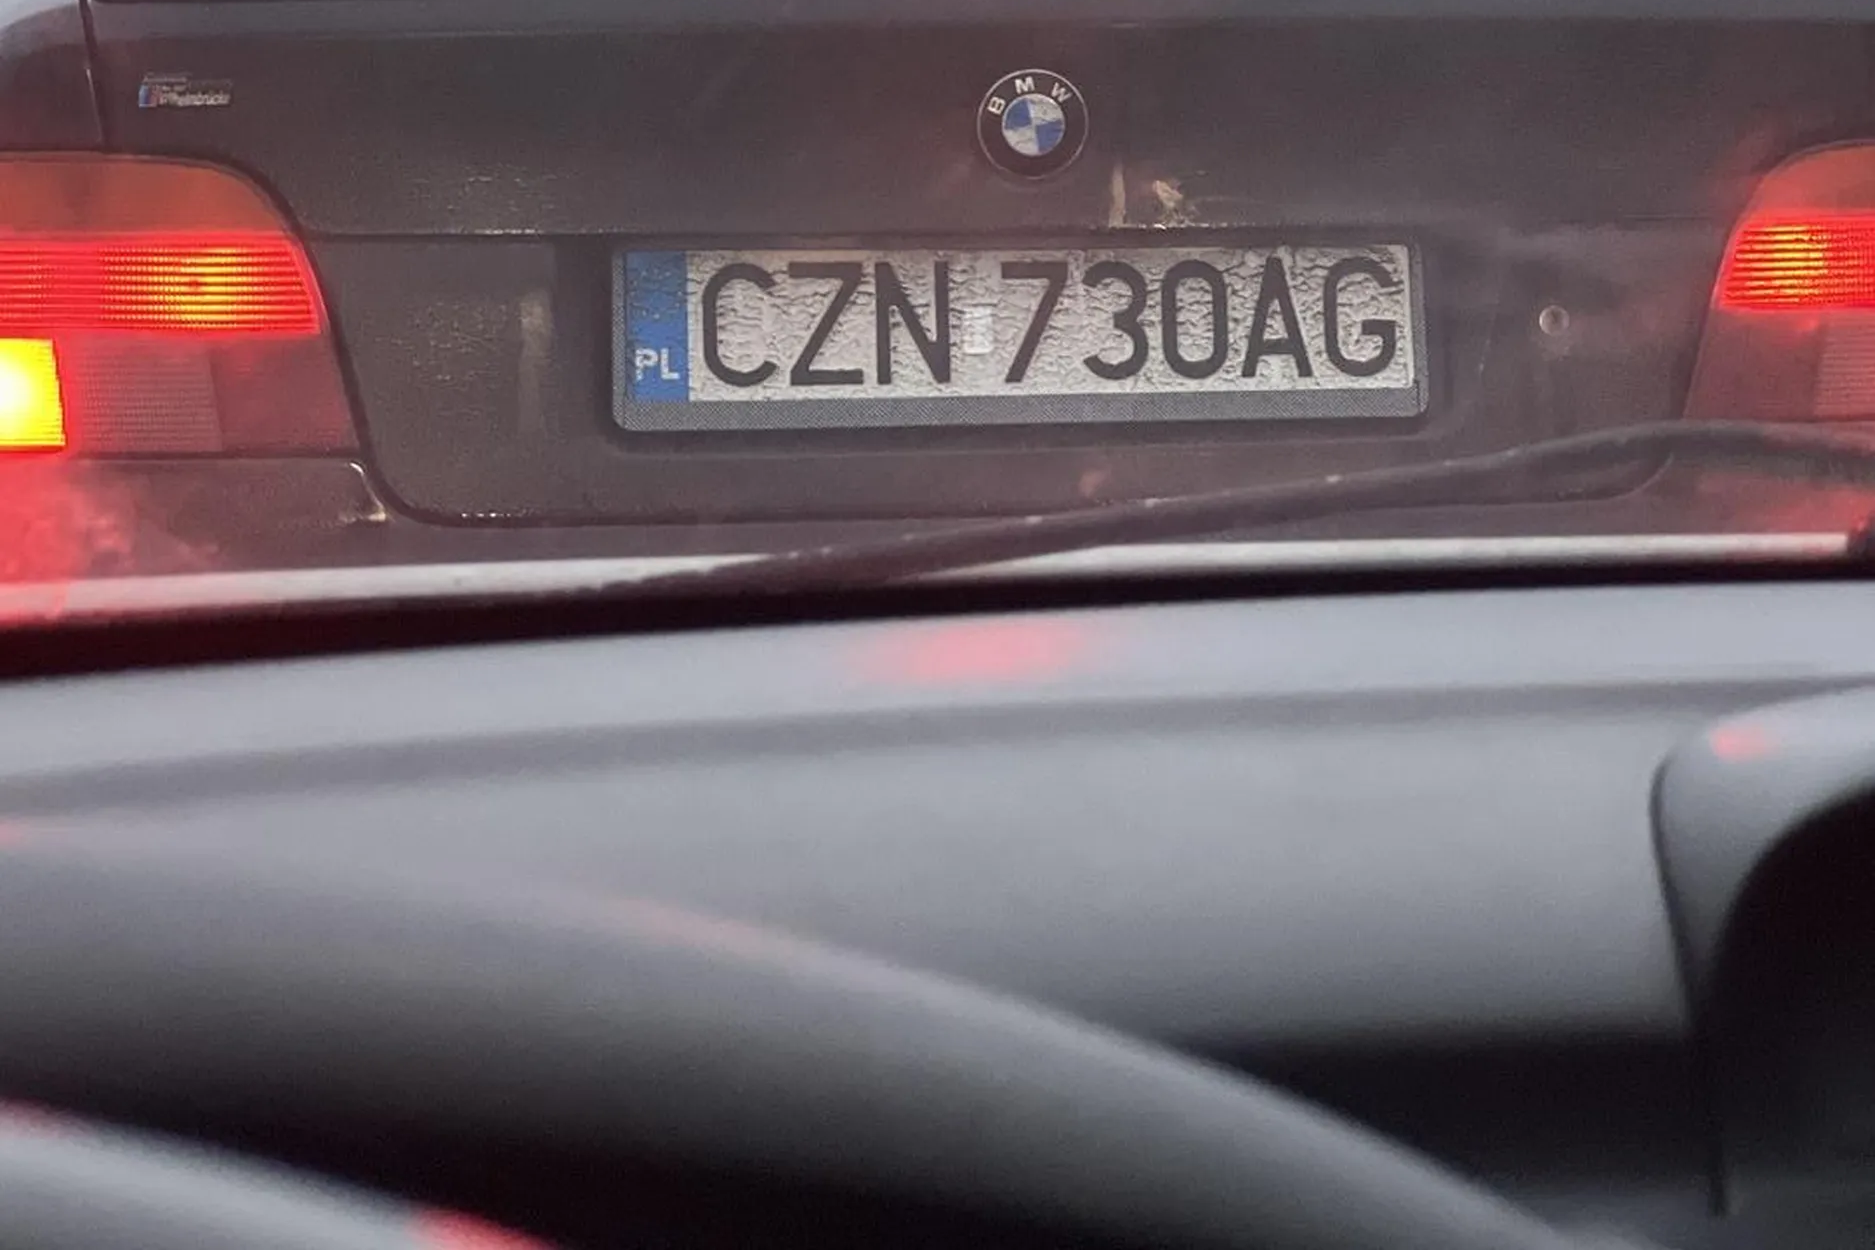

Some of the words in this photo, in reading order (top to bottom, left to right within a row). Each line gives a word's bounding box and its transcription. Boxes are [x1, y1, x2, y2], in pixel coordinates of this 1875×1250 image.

[987, 76, 1073, 115] BMW
[702, 261, 951, 387] CZN
[1001, 255, 1398, 382] 730AG
[635, 347, 680, 381] PL
